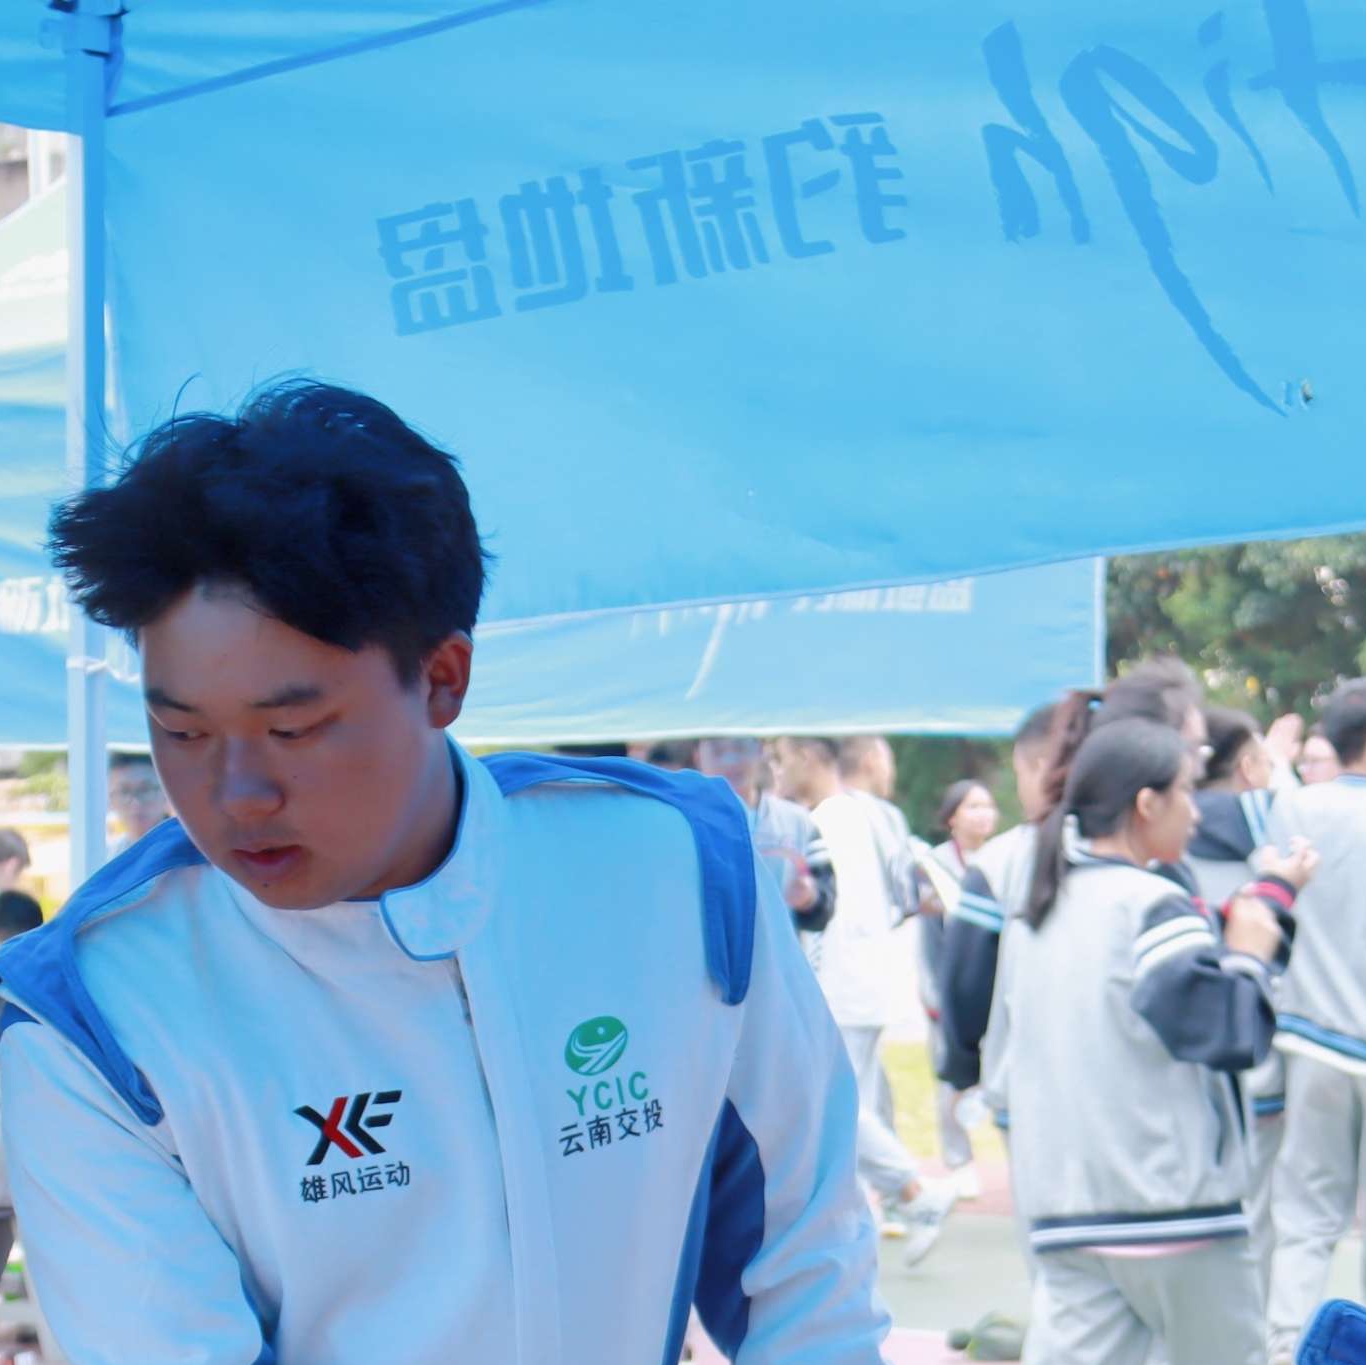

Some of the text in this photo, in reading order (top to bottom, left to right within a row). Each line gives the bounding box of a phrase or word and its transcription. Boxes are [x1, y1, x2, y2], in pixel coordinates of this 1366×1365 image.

[566, 1071, 649, 1117] YCIC
[558, 1098, 664, 1157] 云南交投
[299, 1161, 411, 1203] 雄风运动
